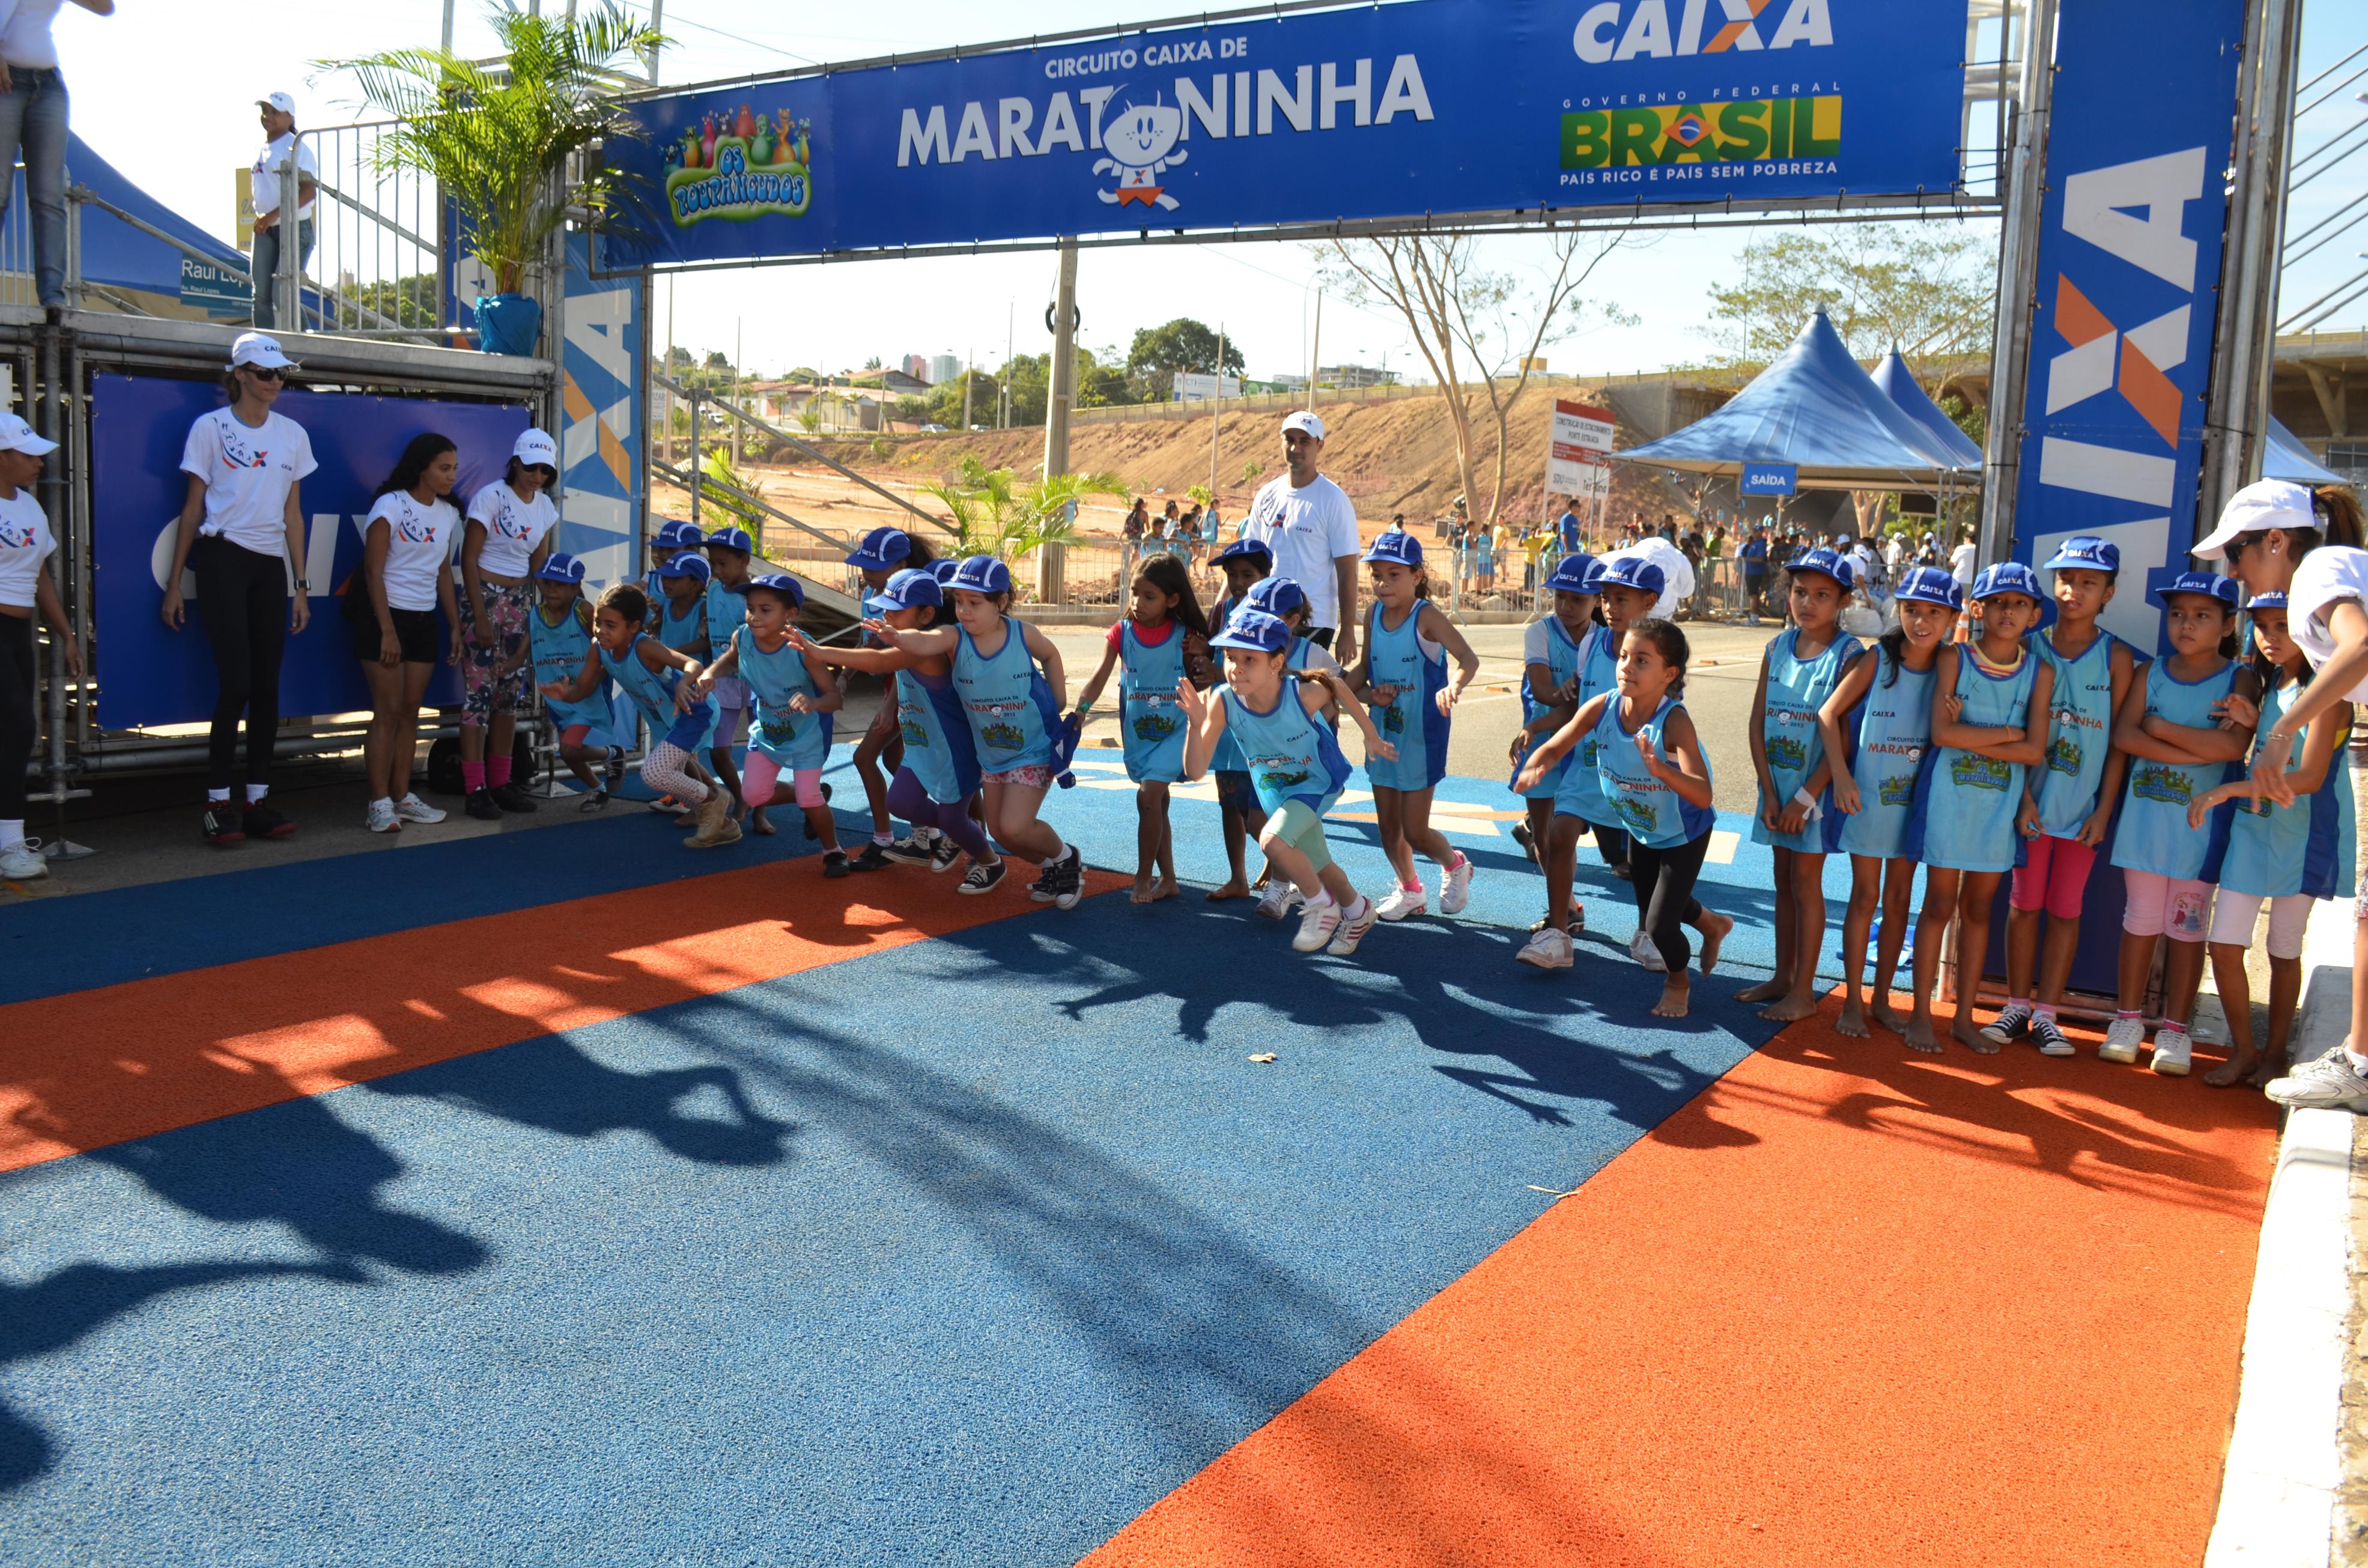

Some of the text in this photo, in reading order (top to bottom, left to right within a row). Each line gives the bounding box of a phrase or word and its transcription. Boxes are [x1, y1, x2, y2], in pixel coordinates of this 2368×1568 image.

[1573, 0, 1833, 64] CAIXA
[1045, 37, 1248, 79] CIRCUITO CAIXA DE
[1563, 81, 1841, 109] GOVERNO FEDERAL
[1559, 96, 1841, 170] BRASIL
[720, 146, 745, 177] OS
[1561, 162, 1838, 186] PAÍS RICO É PAÍS SEM POBREZA
[182, 259, 216, 280] Raul
[530, 443, 551, 452] CAIXA
[1751, 473, 1786, 486] SAÍDA
[2068, 549, 2093, 559] CAIXA
[1808, 557, 1831, 570] CAIXA
[959, 572, 980, 583] CAIXA
[1559, 573, 1578, 583] CAIXA
[1607, 571, 1627, 581] CAIXA
[1997, 577, 2023, 586] CAIXA
[1919, 585, 1944, 596] CAIXA
[2181, 581, 2207, 590] CAIXA
[1013, 671, 1031, 680] CAIXA
[1287, 730, 1309, 743] CAIXA
